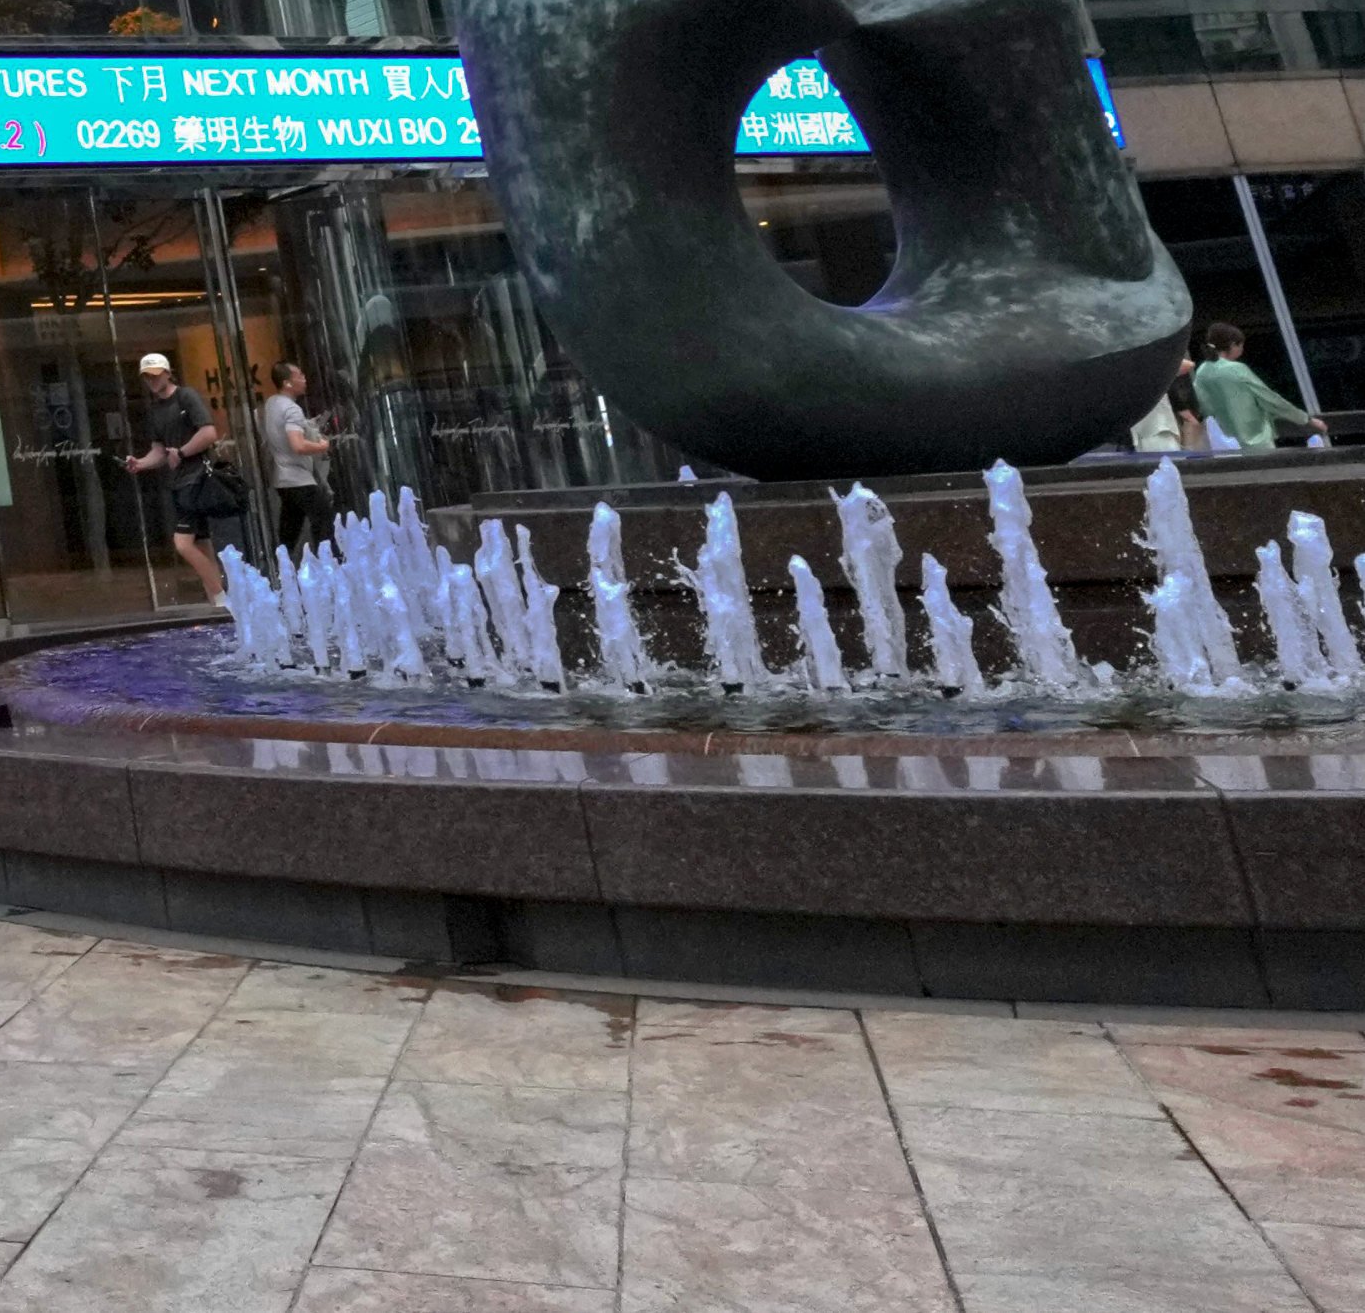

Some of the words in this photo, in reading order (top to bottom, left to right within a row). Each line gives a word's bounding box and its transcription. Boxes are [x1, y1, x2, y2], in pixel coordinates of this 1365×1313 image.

[101, 64, 167, 104] 下月
[182, 69, 258, 96] NEXT
[267, 68, 370, 96] MONTH
[76, 119, 161, 150] 02269
[172, 114, 308, 155] 藥明生物
[317, 117, 393, 147] WUXI
[401, 116, 447, 146] BIO
[740, 111, 857, 147] 申洲國際
